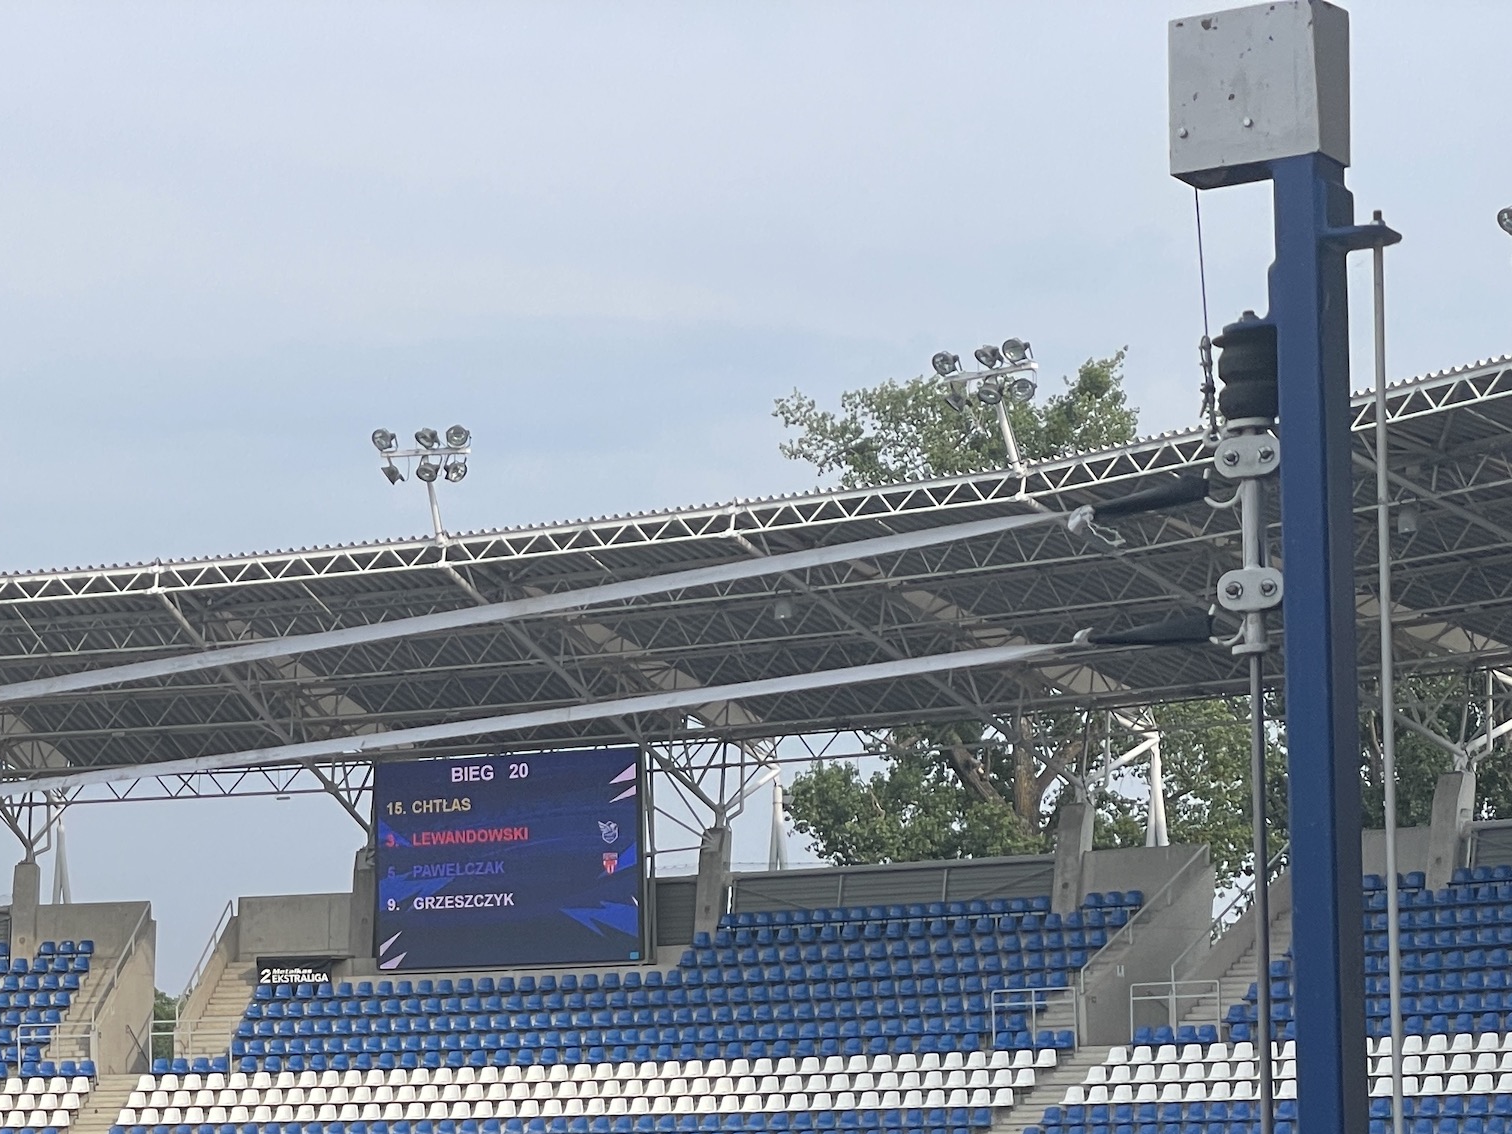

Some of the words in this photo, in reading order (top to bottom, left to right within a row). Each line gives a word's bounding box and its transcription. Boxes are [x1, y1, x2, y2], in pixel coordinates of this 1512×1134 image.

[451, 765, 494, 782] BIEG
[509, 763, 529, 779] 20
[387, 801, 406, 815] 15.
[413, 827, 529, 846] LEWANDOWSKI
[387, 898, 400, 911] 9.
[413, 893, 515, 911] GRZESZCZYK
[260, 968, 272, 983] 2
[272, 973, 329, 983] EKSTRALIGA
